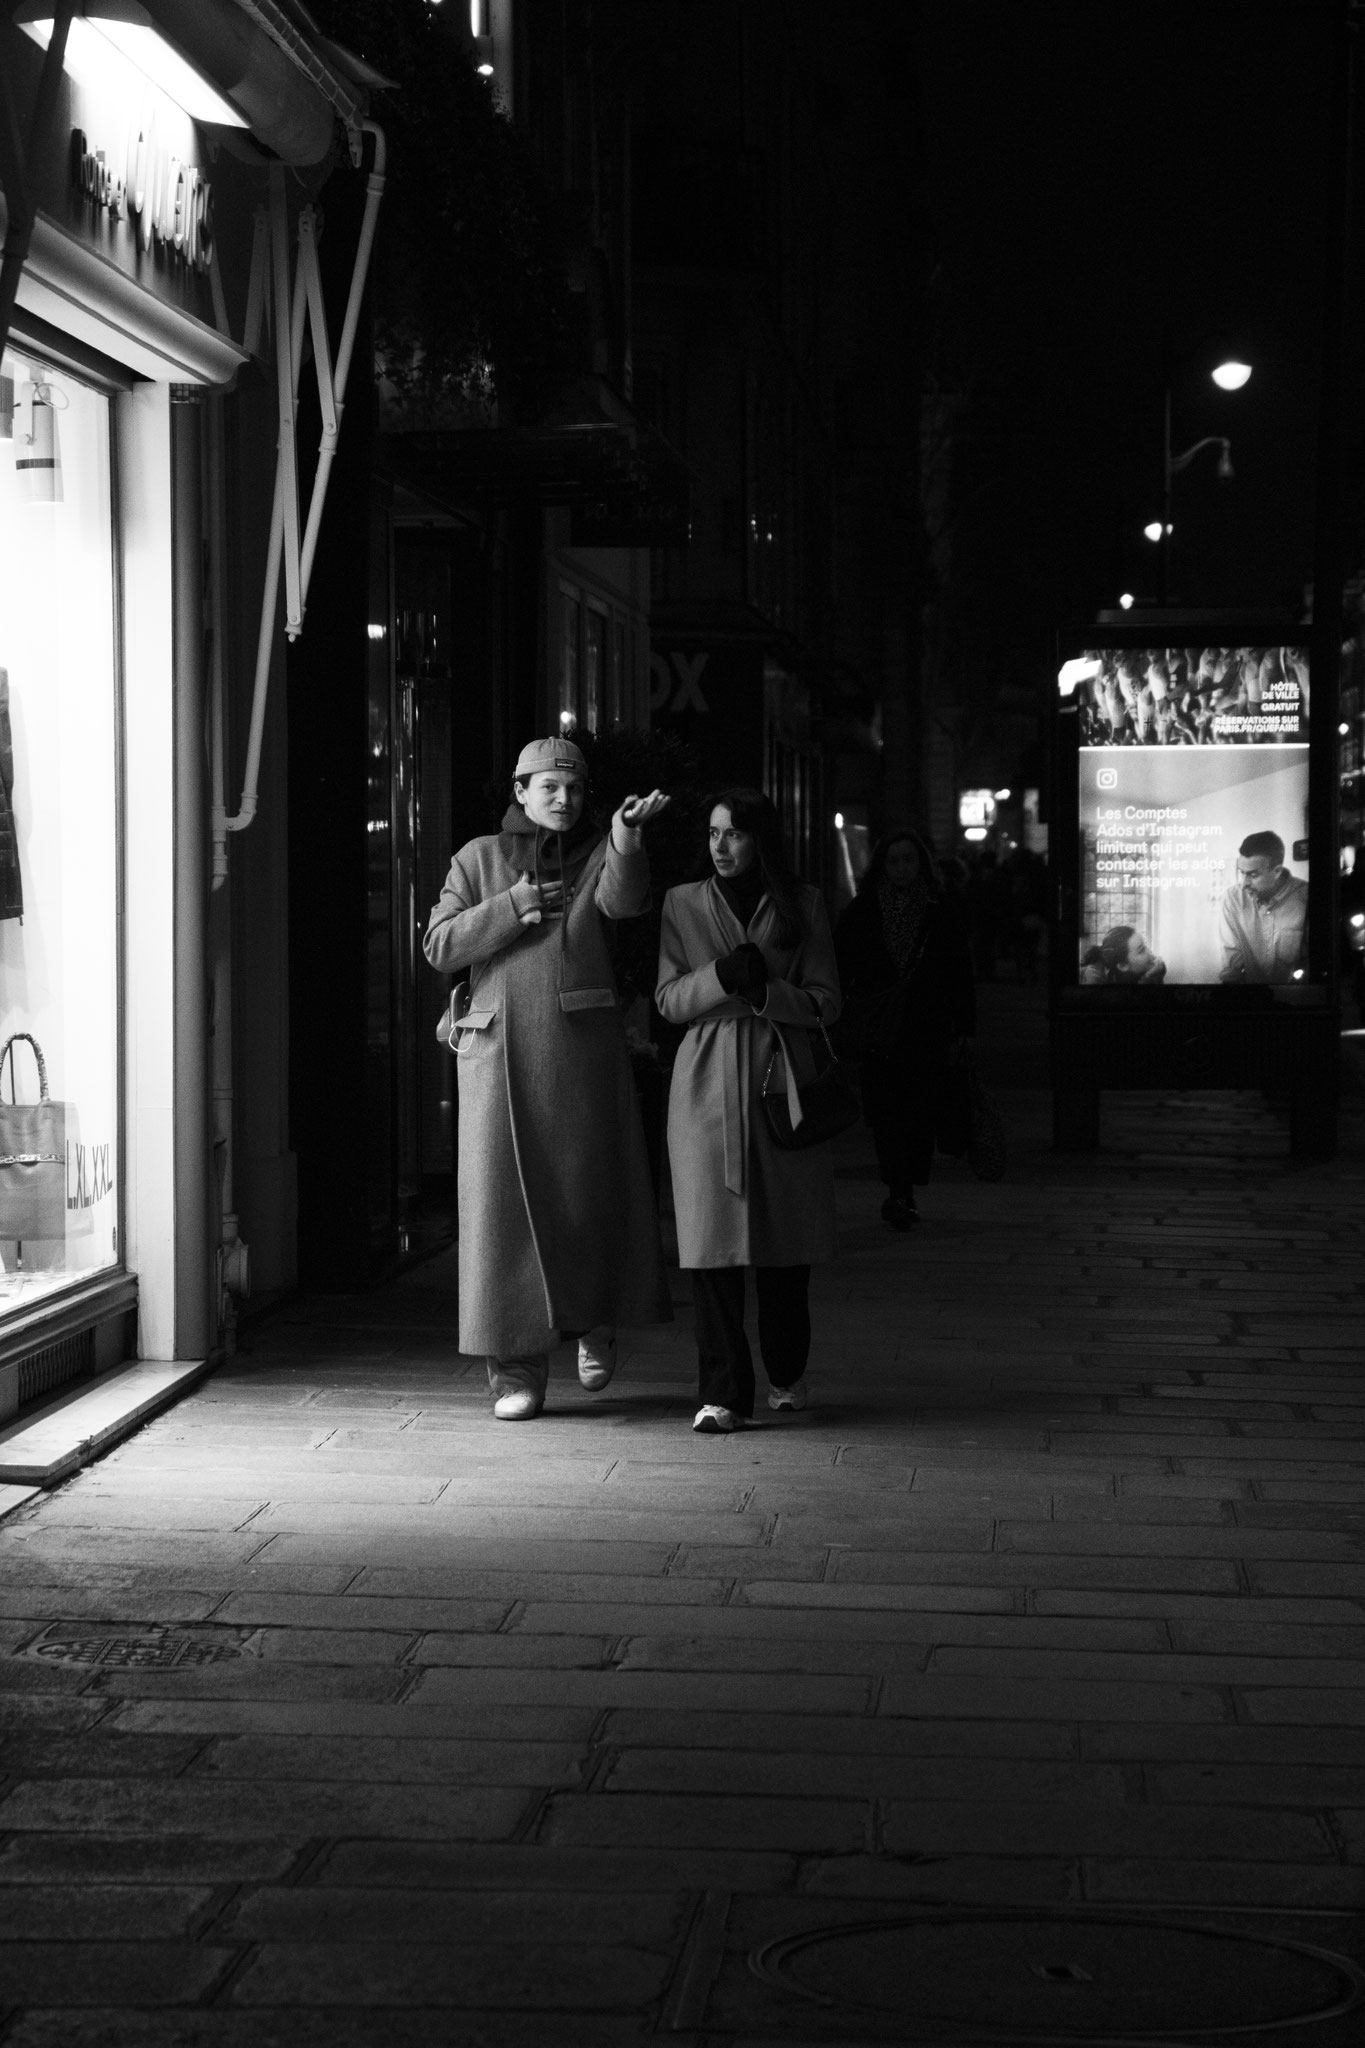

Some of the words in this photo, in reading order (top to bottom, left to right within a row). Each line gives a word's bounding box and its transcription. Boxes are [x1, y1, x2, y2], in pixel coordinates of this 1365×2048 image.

[1270, 681, 1299, 691] HÔTEL
[1262, 691, 1274, 699] DE
[1275, 691, 1299, 699] VILLE
[1261, 703, 1300, 711] GRATUIT
[1215, 715, 1280, 724] RÉSERVATIONS
[1281, 715, 1299, 724] SUR
[1096, 806, 1121, 820] Les
[1125, 805, 1187, 822] Comptes
[1096, 823, 1133, 836] Ados
[1136, 823, 1222, 839] d'Instagram
[1096, 840, 1147, 853] limitent
[1151, 840, 1172, 856] qui
[1176, 841, 1207, 856] peut
[1096, 858, 1164, 870] contacter
[1168, 857, 1188, 870] les
[1191, 857, 1226, 869] ados
[1096, 876, 1119, 887] sur
